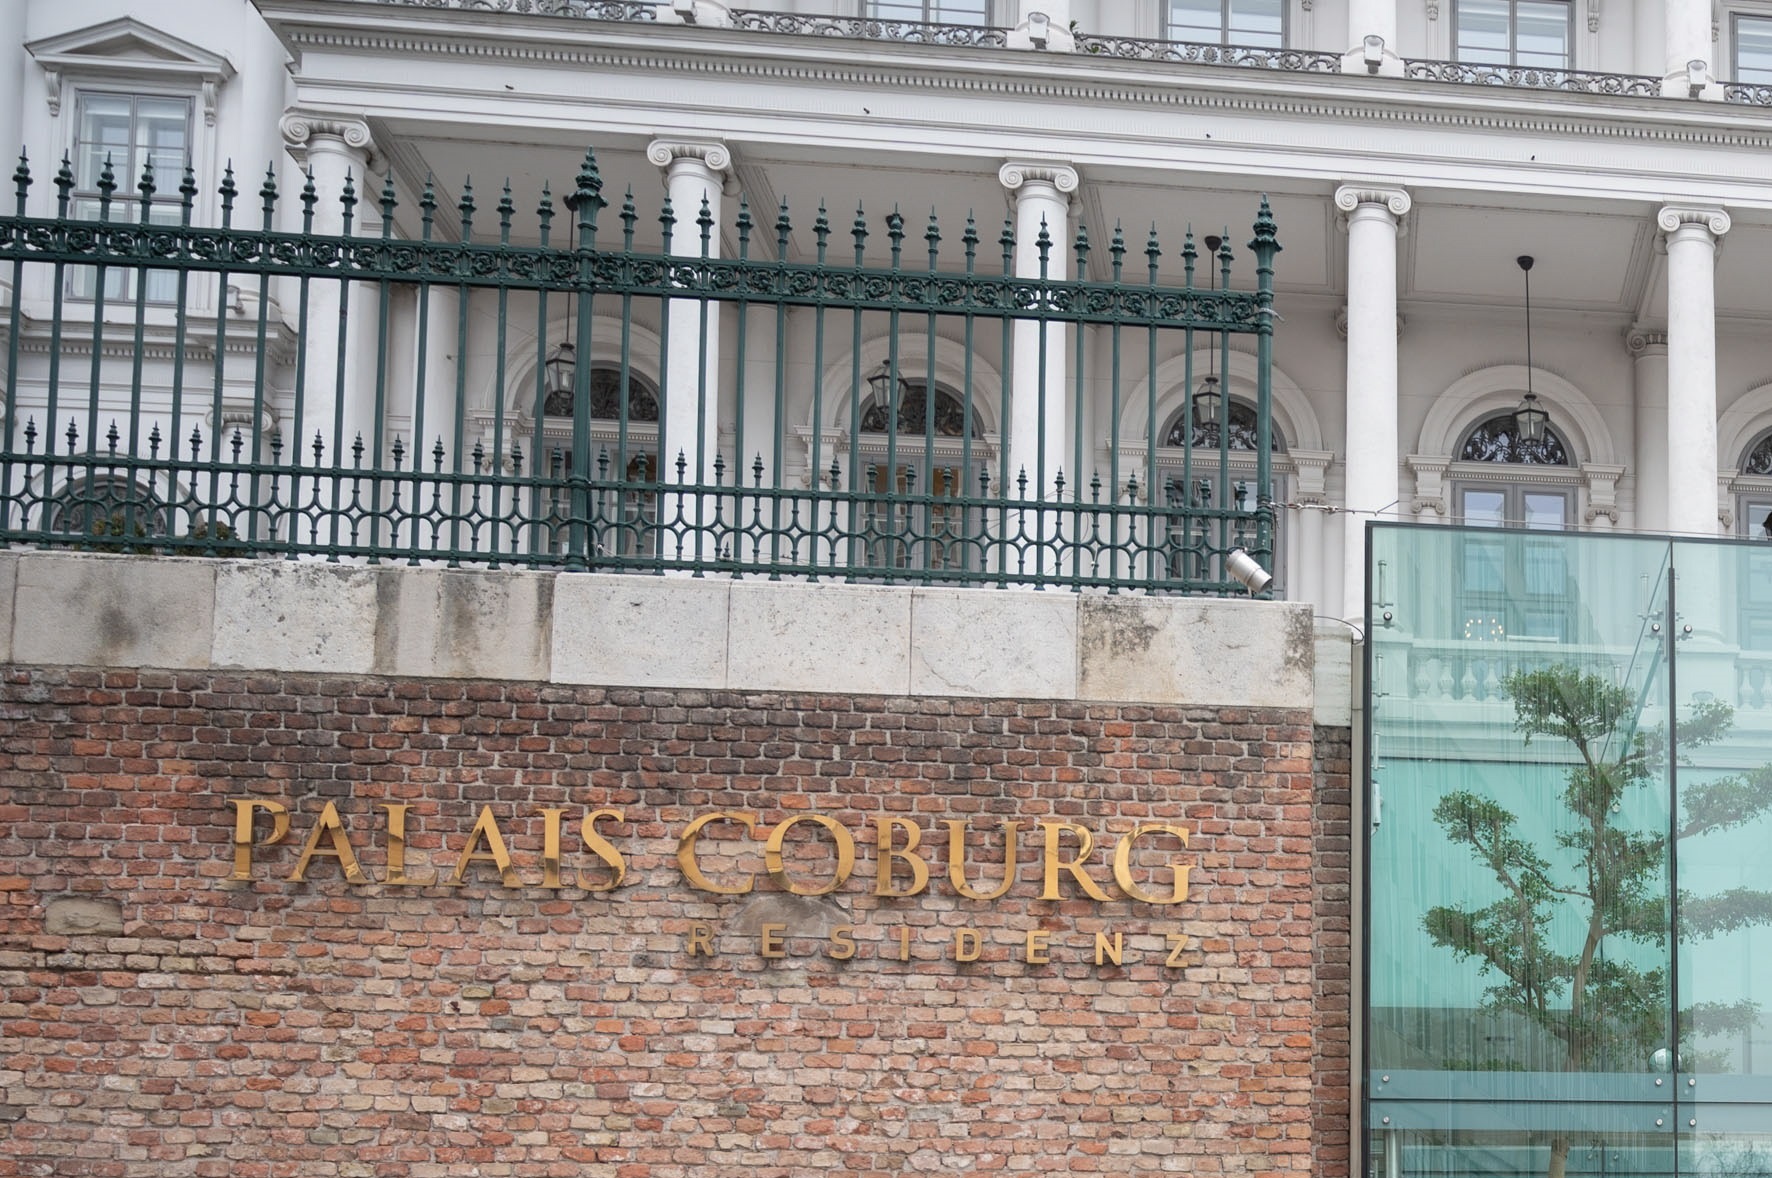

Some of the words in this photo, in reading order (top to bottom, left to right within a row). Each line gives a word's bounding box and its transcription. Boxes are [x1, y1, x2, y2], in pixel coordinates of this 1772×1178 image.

[225, 798, 628, 893] PALAIS
[675, 811, 1198, 905] COBURG
[686, 921, 1190, 968] RESIDENZ
